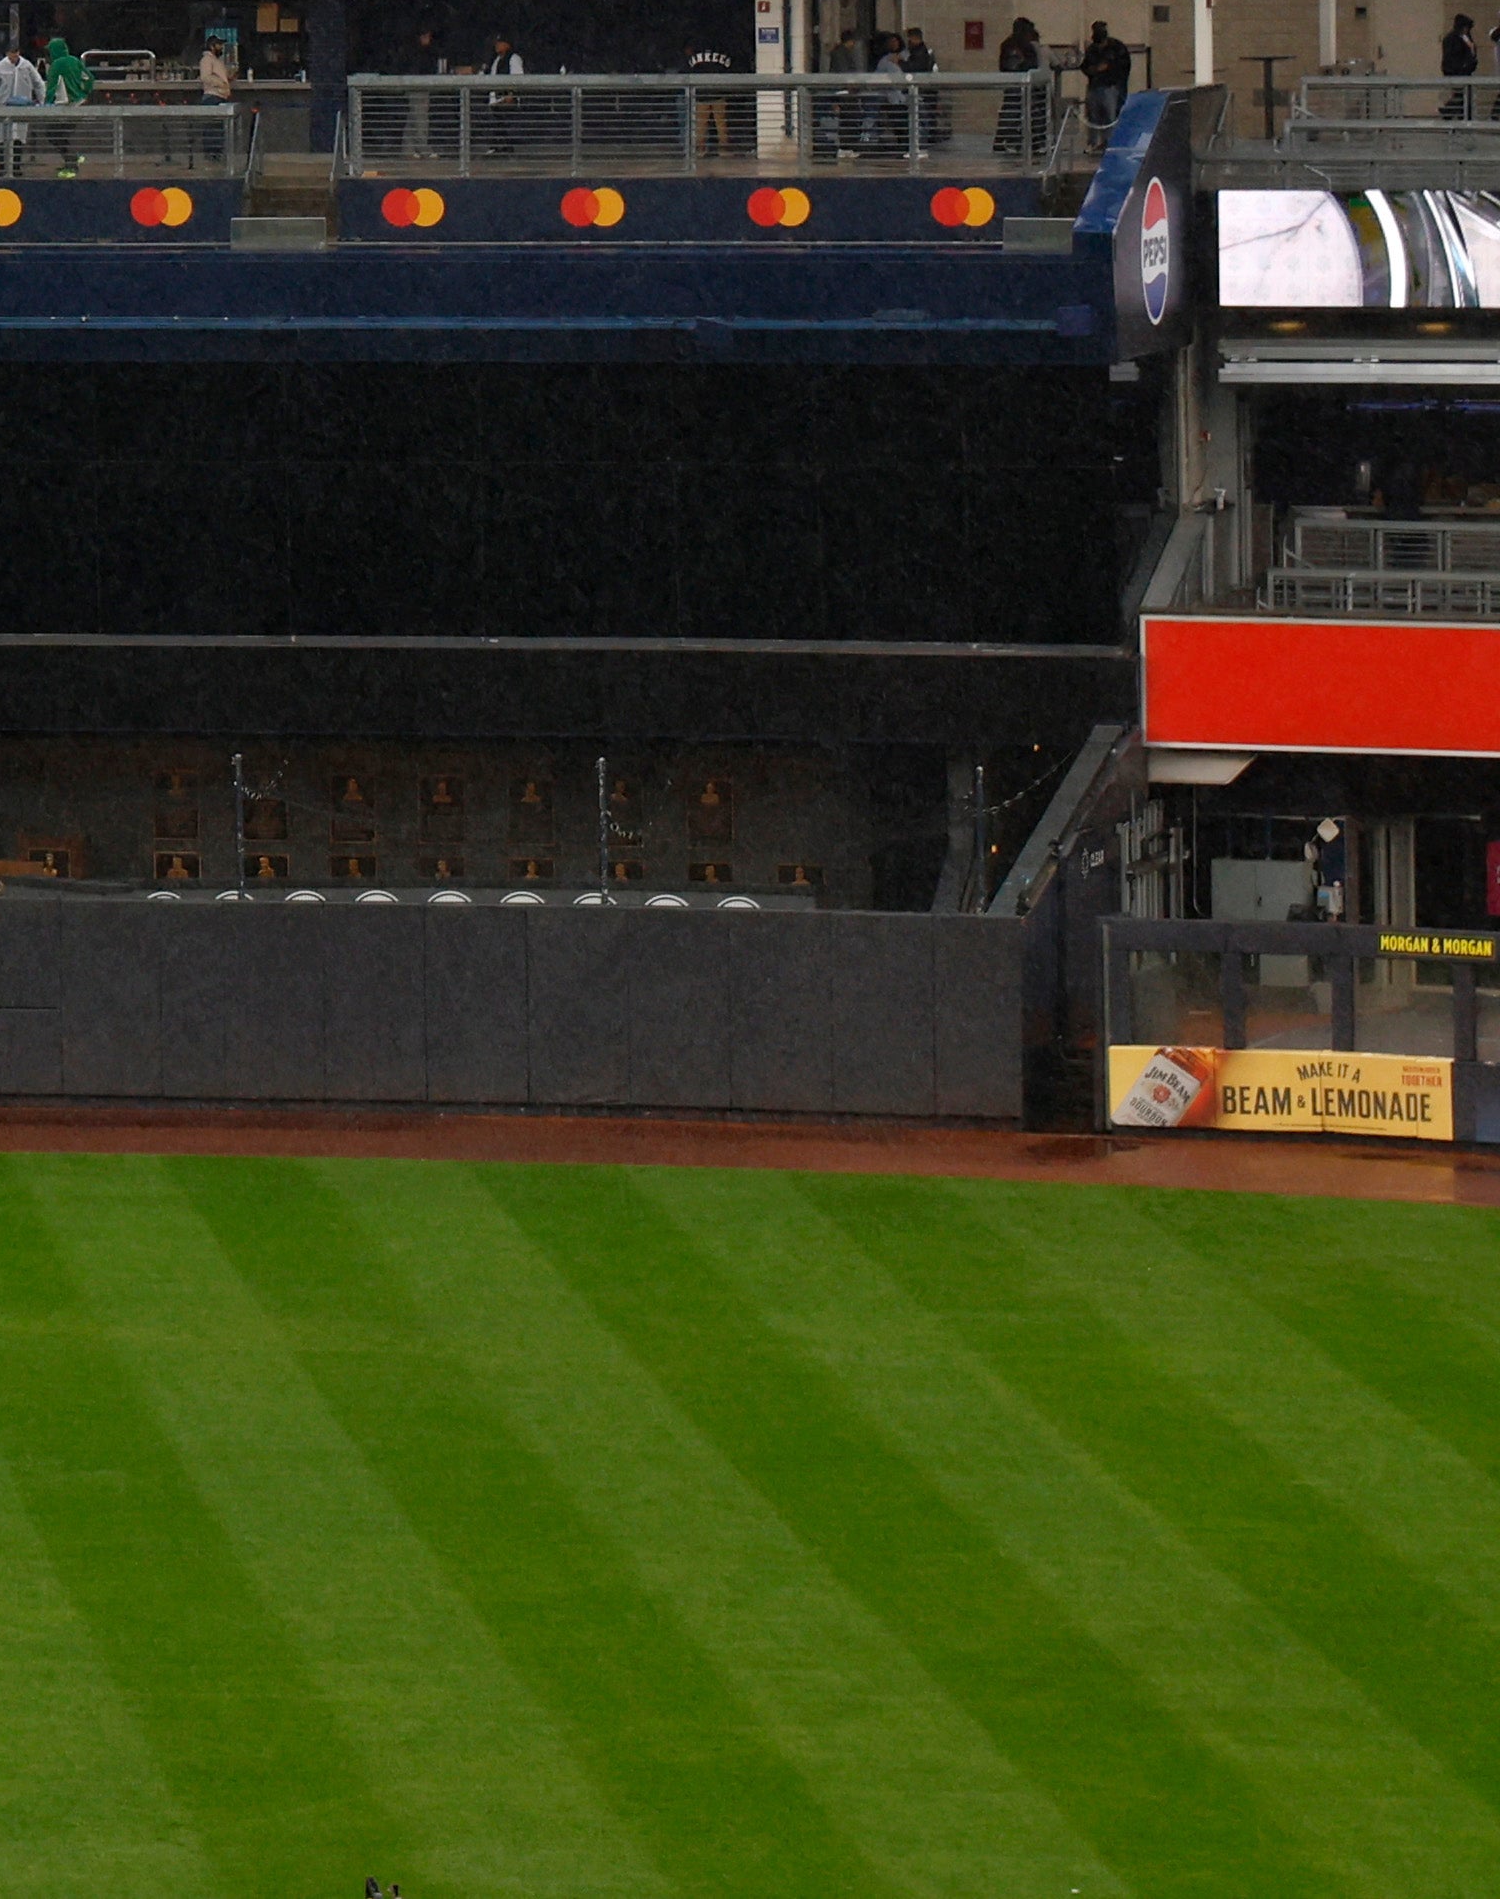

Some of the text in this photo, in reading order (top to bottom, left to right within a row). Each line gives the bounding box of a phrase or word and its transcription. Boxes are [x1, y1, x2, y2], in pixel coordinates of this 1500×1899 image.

[1380, 935, 1492, 957] MORGAN & MORGAN
[1296, 1061, 1361, 1084] MAKE IT A
[1223, 1085, 1432, 1122] BEAM & LEMONADE
